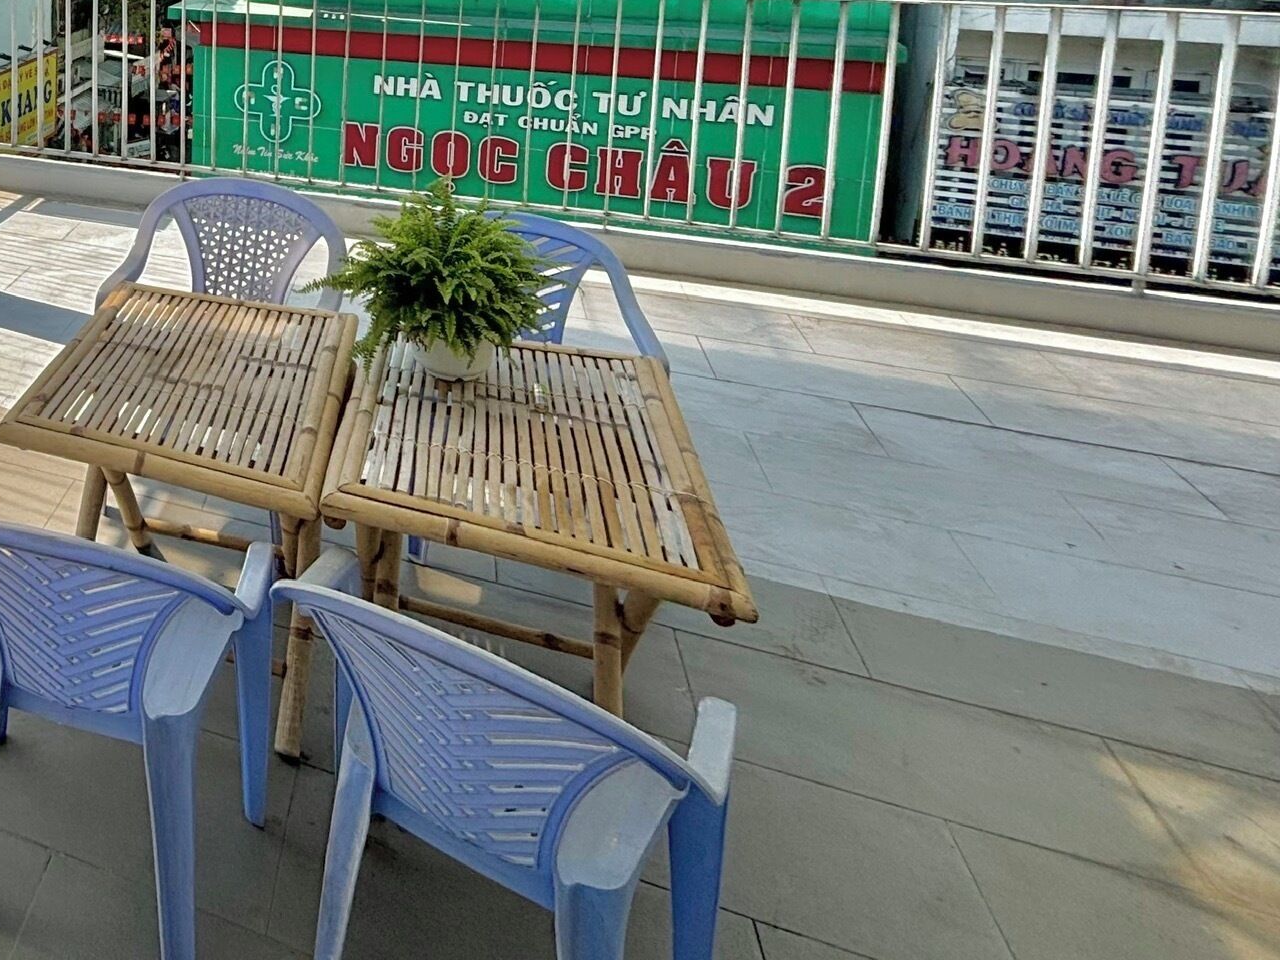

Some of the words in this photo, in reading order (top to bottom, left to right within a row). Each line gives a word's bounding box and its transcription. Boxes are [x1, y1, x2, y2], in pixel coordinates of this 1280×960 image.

[373, 72, 442, 100] NHÀ
[456, 80, 579, 112] THUỐC
[592, 90, 648, 117] TƯ
[661, 95, 775, 127] NHÂN
[463, 111, 509, 128] ĐẠT
[342, 121, 520, 193] NGỌC
[545, 138, 758, 210] CHÂU
[782, 164, 828, 218] 2
